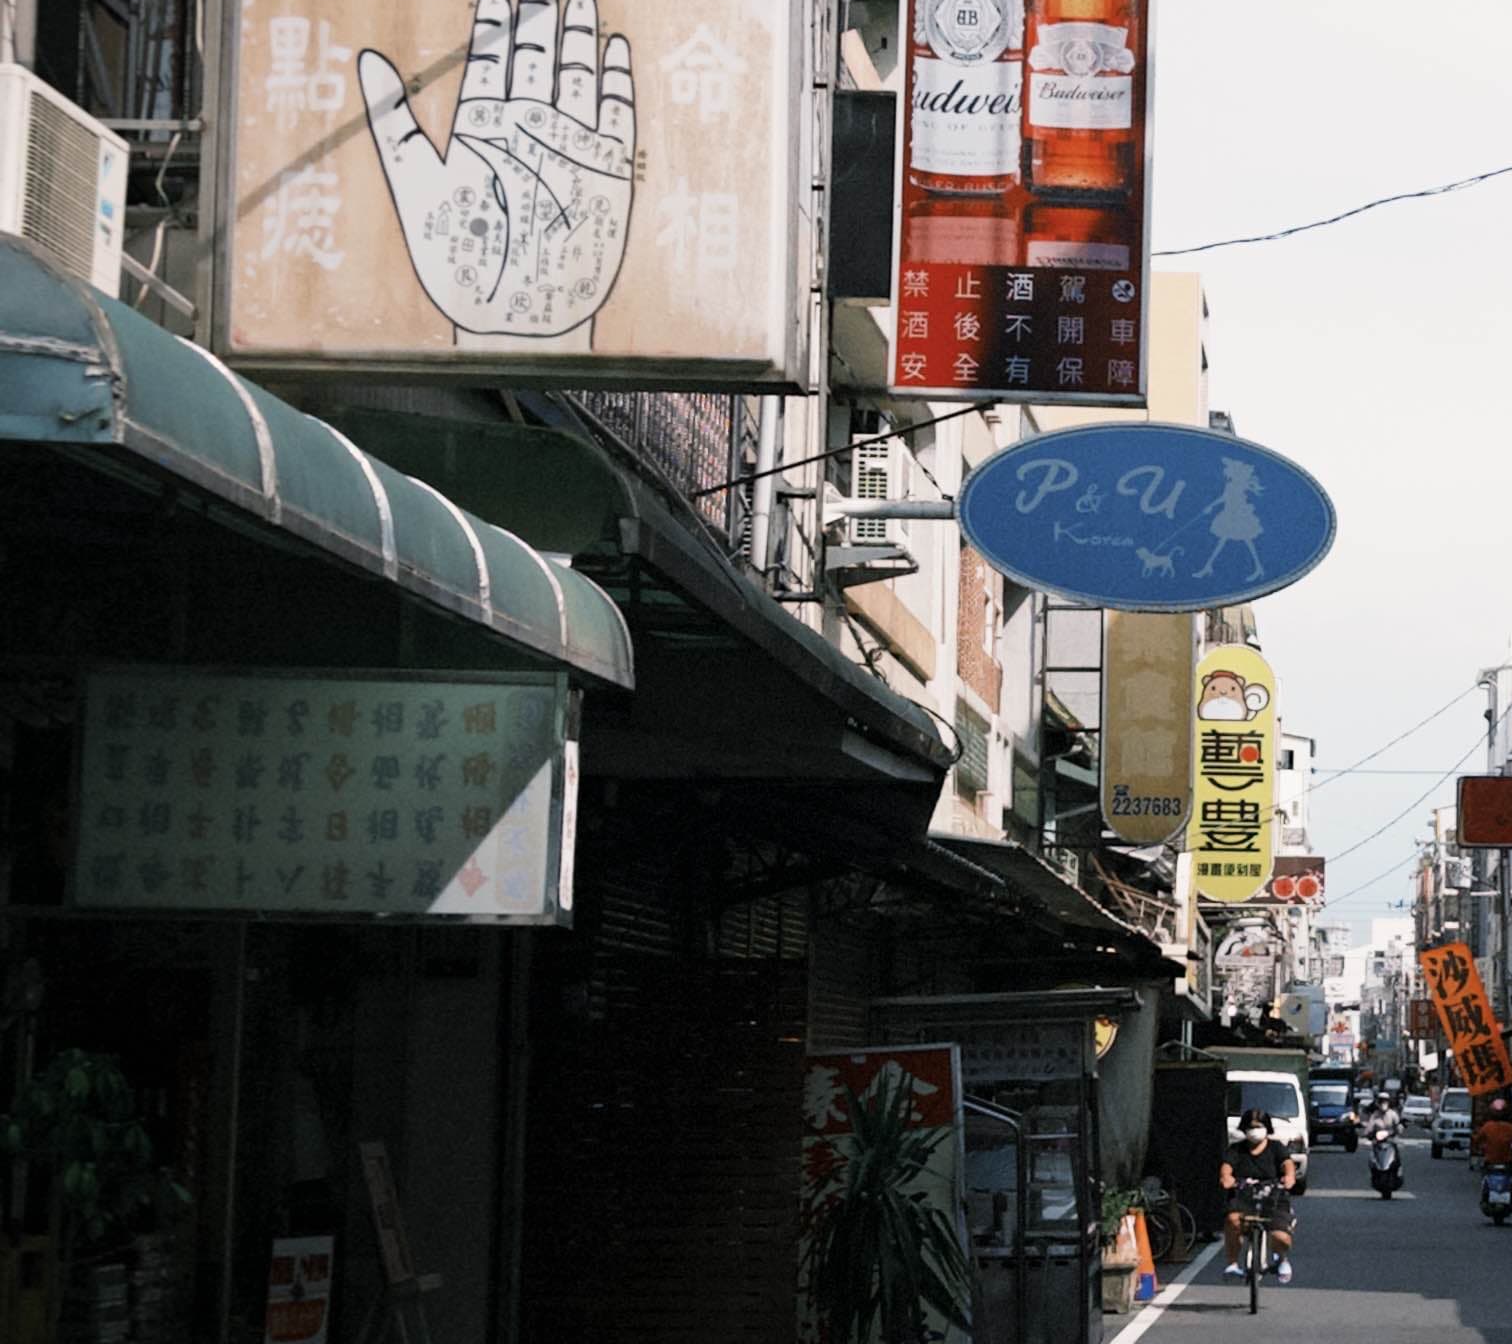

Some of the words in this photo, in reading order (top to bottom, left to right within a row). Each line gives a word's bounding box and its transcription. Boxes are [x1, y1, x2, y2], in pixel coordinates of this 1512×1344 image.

[1039, 81, 1126, 101] Budweiser
[903, 269, 1086, 304] 禁止酒駕
[901, 311, 1136, 345] 酒後不開車
[901, 352, 1136, 387] 安全有保障
[1112, 797, 1182, 816] 2237683
